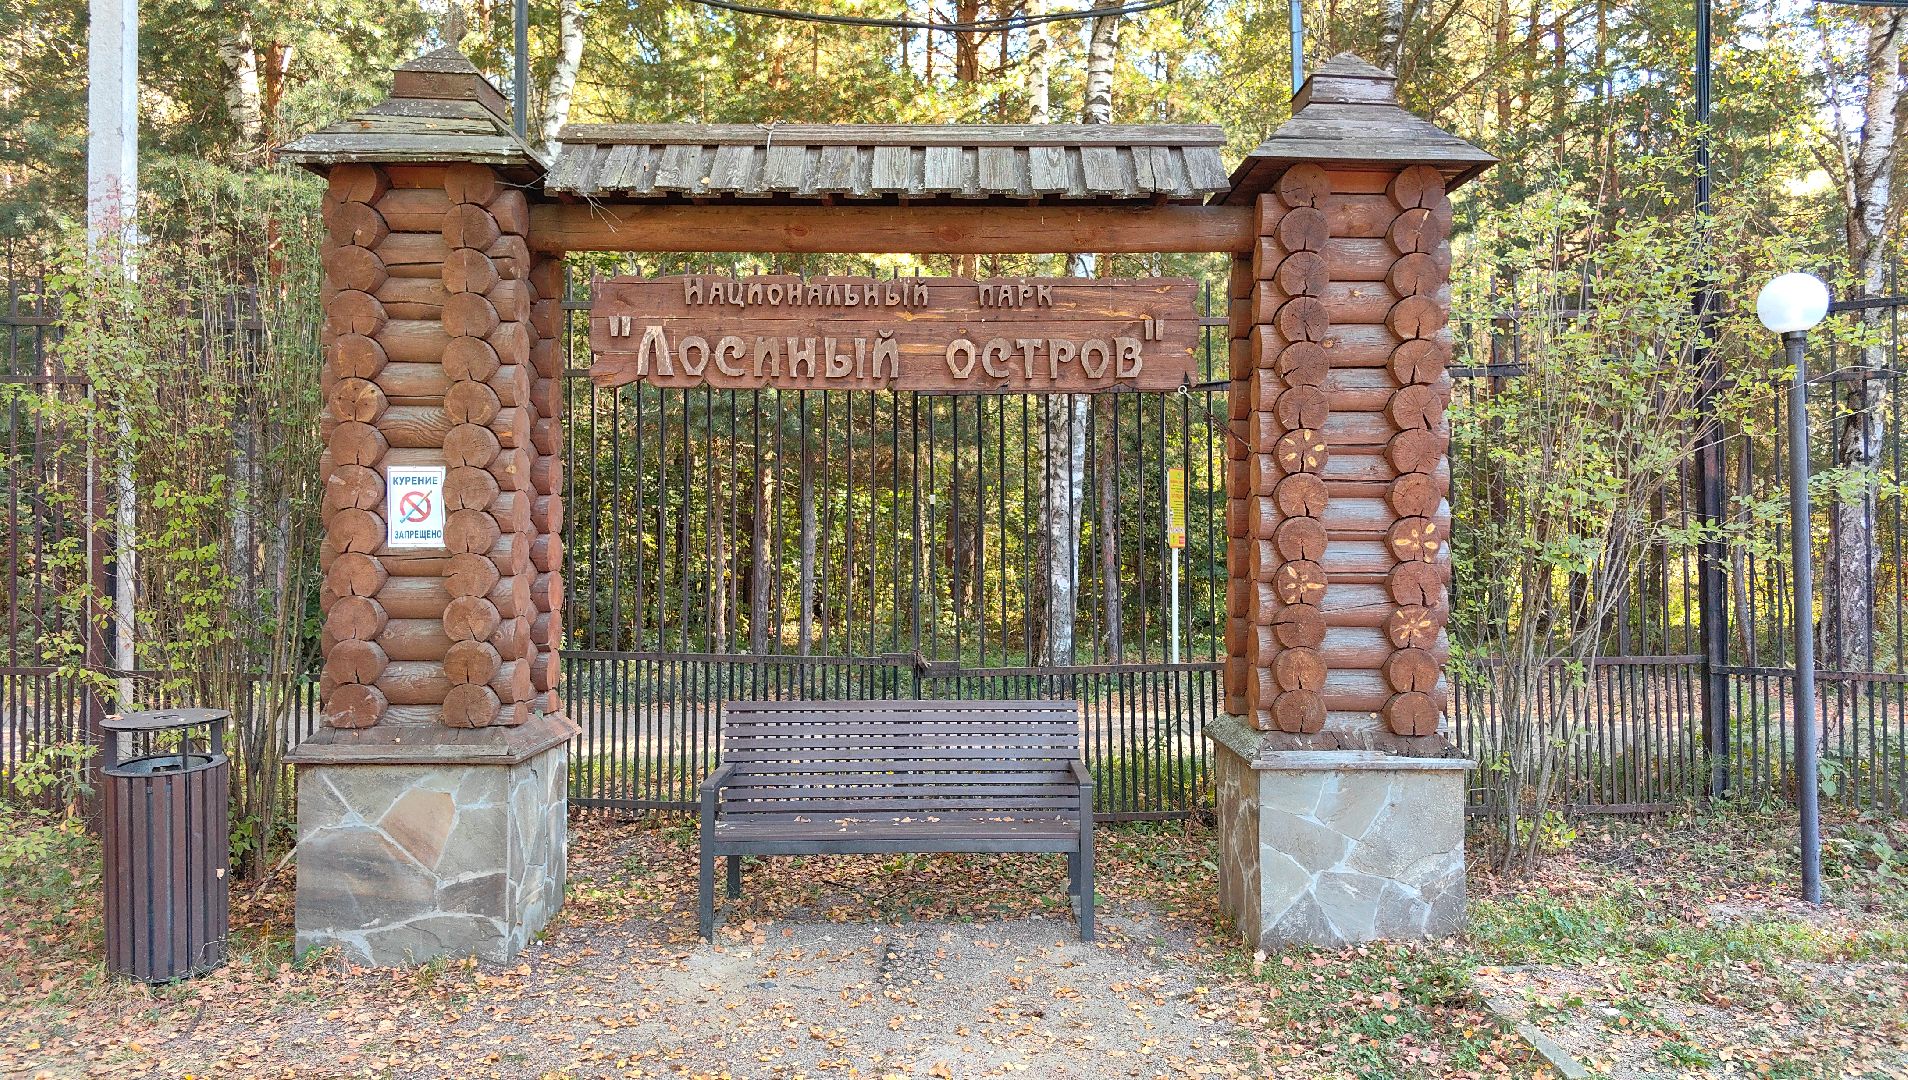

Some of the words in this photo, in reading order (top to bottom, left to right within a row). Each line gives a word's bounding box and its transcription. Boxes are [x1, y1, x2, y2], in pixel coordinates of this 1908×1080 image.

[978, 284, 1053, 308] ПАРК
[945, 318, 1165, 380] ОСТРОВ"
[392, 476, 439, 486] КУРЕНИЕ
[394, 530, 442, 540] ЗАПРЕЩЕНО
